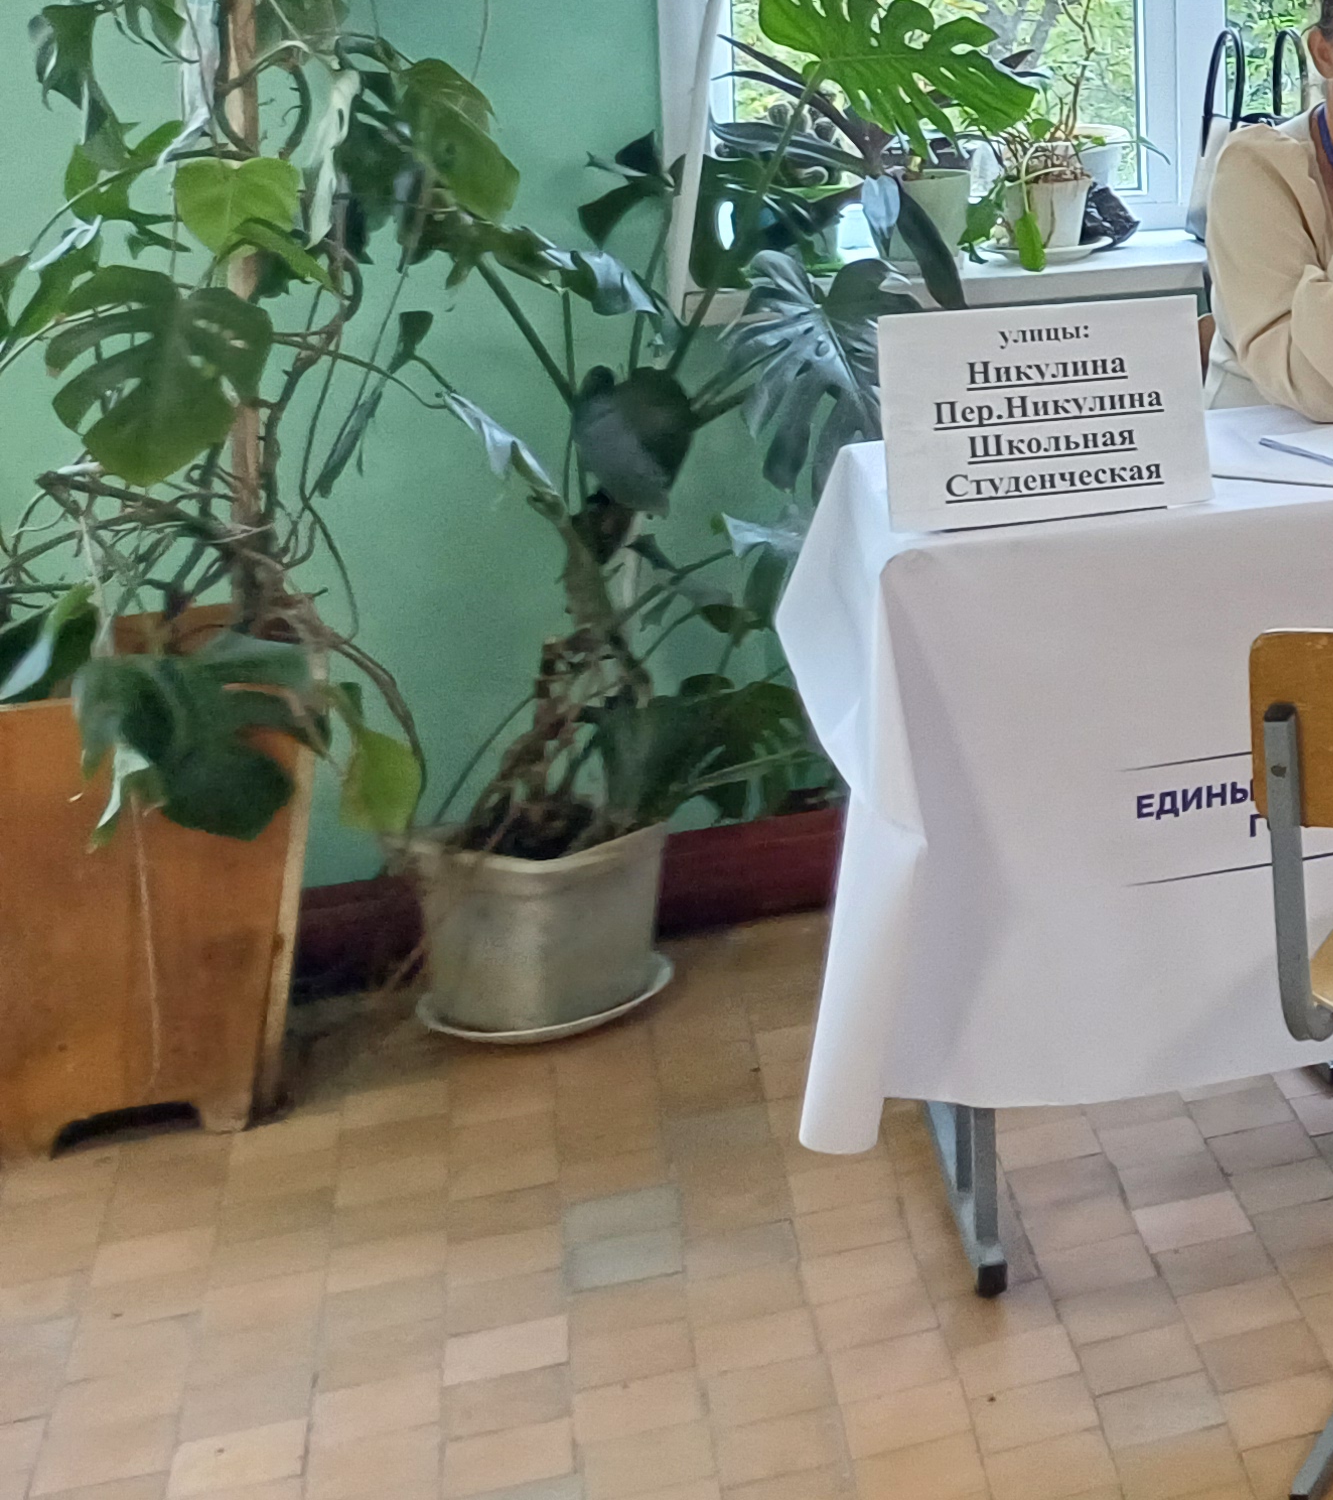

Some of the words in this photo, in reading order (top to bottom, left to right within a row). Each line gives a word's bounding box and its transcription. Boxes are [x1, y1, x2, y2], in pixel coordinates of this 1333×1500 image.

[999, 324, 1091, 349] улицы:
[966, 354, 1128, 386] Никулина
[934, 389, 1164, 426] Пер.Никулина
[967, 428, 1137, 460] Школьная
[945, 462, 1164, 499] Студенческая
[1136, 779, 1254, 821] ЕДИНЫ
